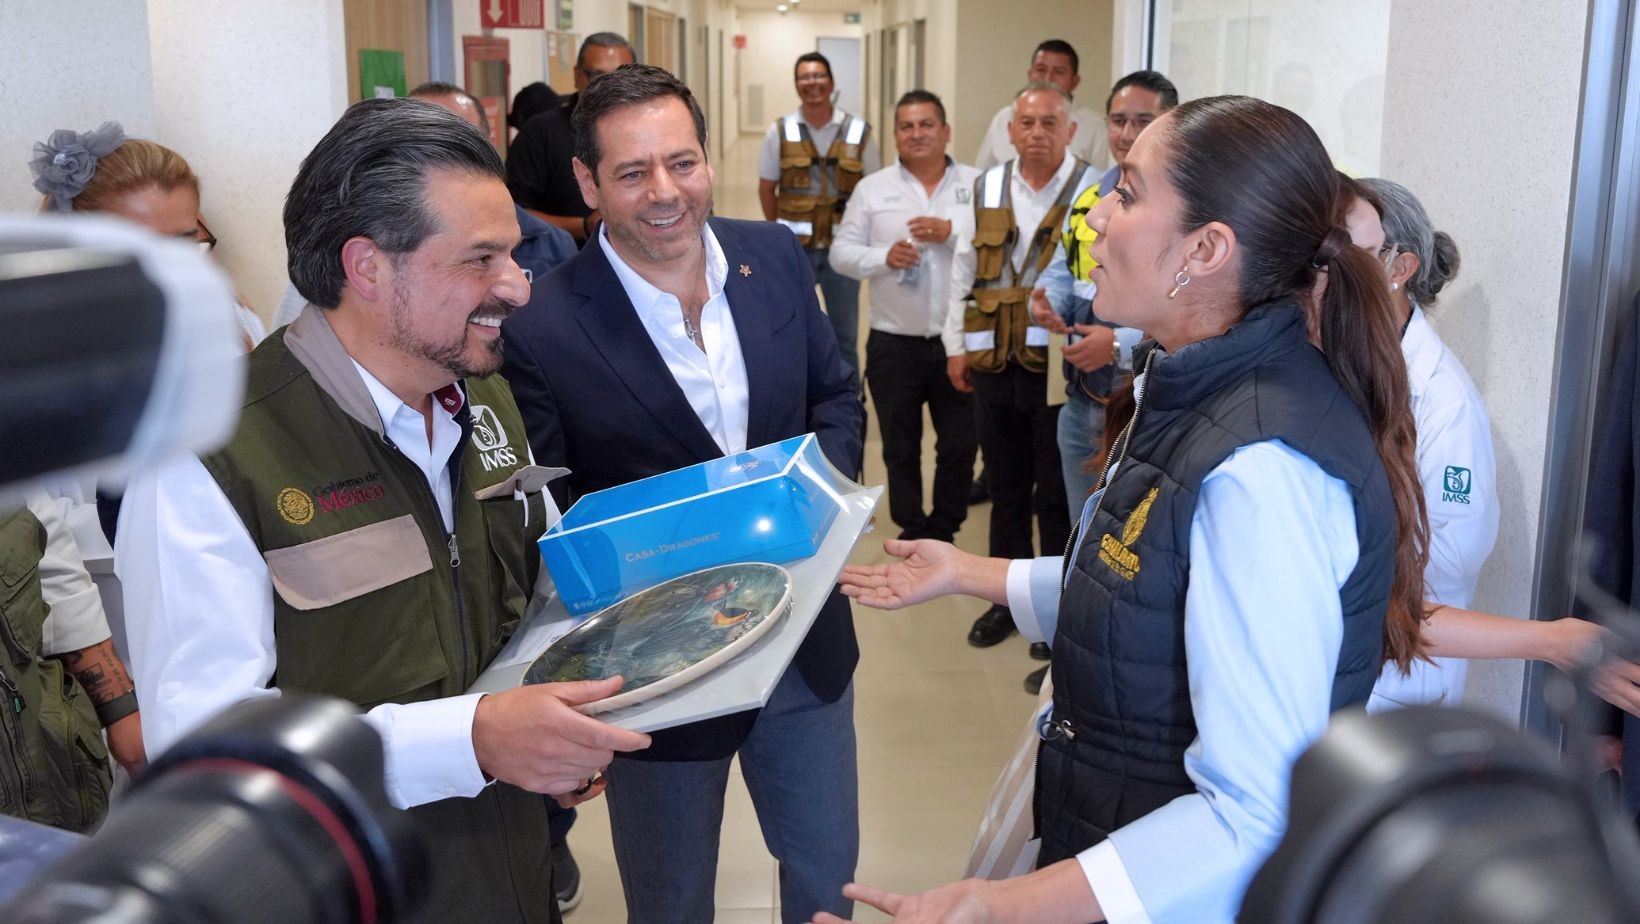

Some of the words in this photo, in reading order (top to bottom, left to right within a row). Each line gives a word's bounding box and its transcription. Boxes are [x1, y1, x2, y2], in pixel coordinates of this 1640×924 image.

[480, 447, 518, 471] IMSS
[313, 476, 364, 497] Gobierno
[365, 471, 380, 482] de
[316, 484, 385, 513] México
[1442, 492, 1470, 504] IMSS
